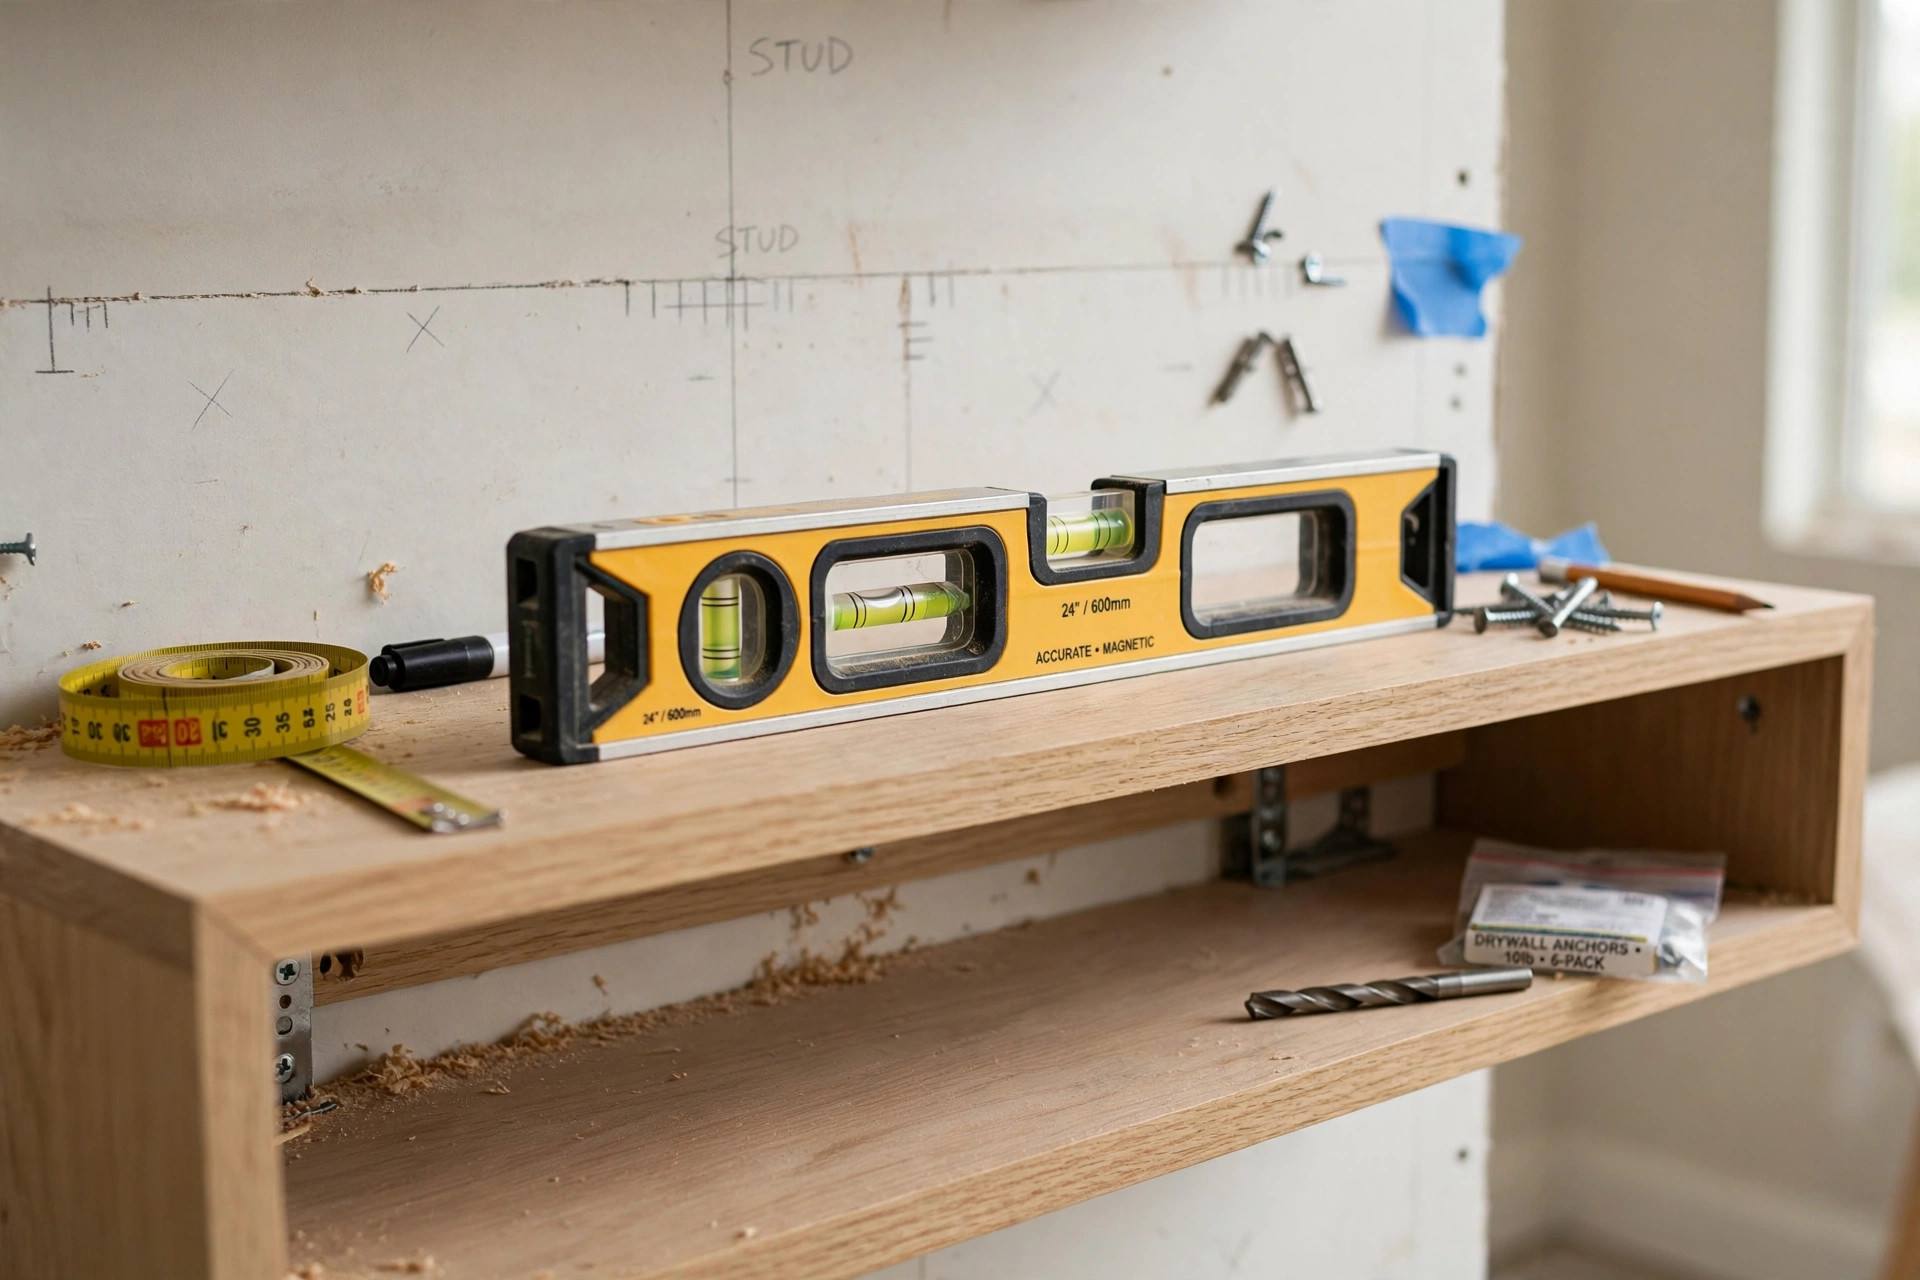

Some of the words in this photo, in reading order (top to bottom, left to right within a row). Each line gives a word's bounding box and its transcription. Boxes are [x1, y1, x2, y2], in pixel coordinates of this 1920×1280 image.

[749, 35, 853, 76] STUD
[715, 224, 799, 259] STUD
[1061, 601, 1080, 618] 24"
[1091, 596, 1131, 614] 600mm
[1035, 645, 1092, 665] ACCURATE
[1102, 636, 1155, 655] MAGNETIC
[667, 707, 701, 721] 600mm
[1474, 933, 1548, 951] DRYWALL
[1552, 938, 1629, 955] ANCHORS
[1504, 950, 1535, 965] 10lb
[1550, 953, 1605, 970] 6-PACK
